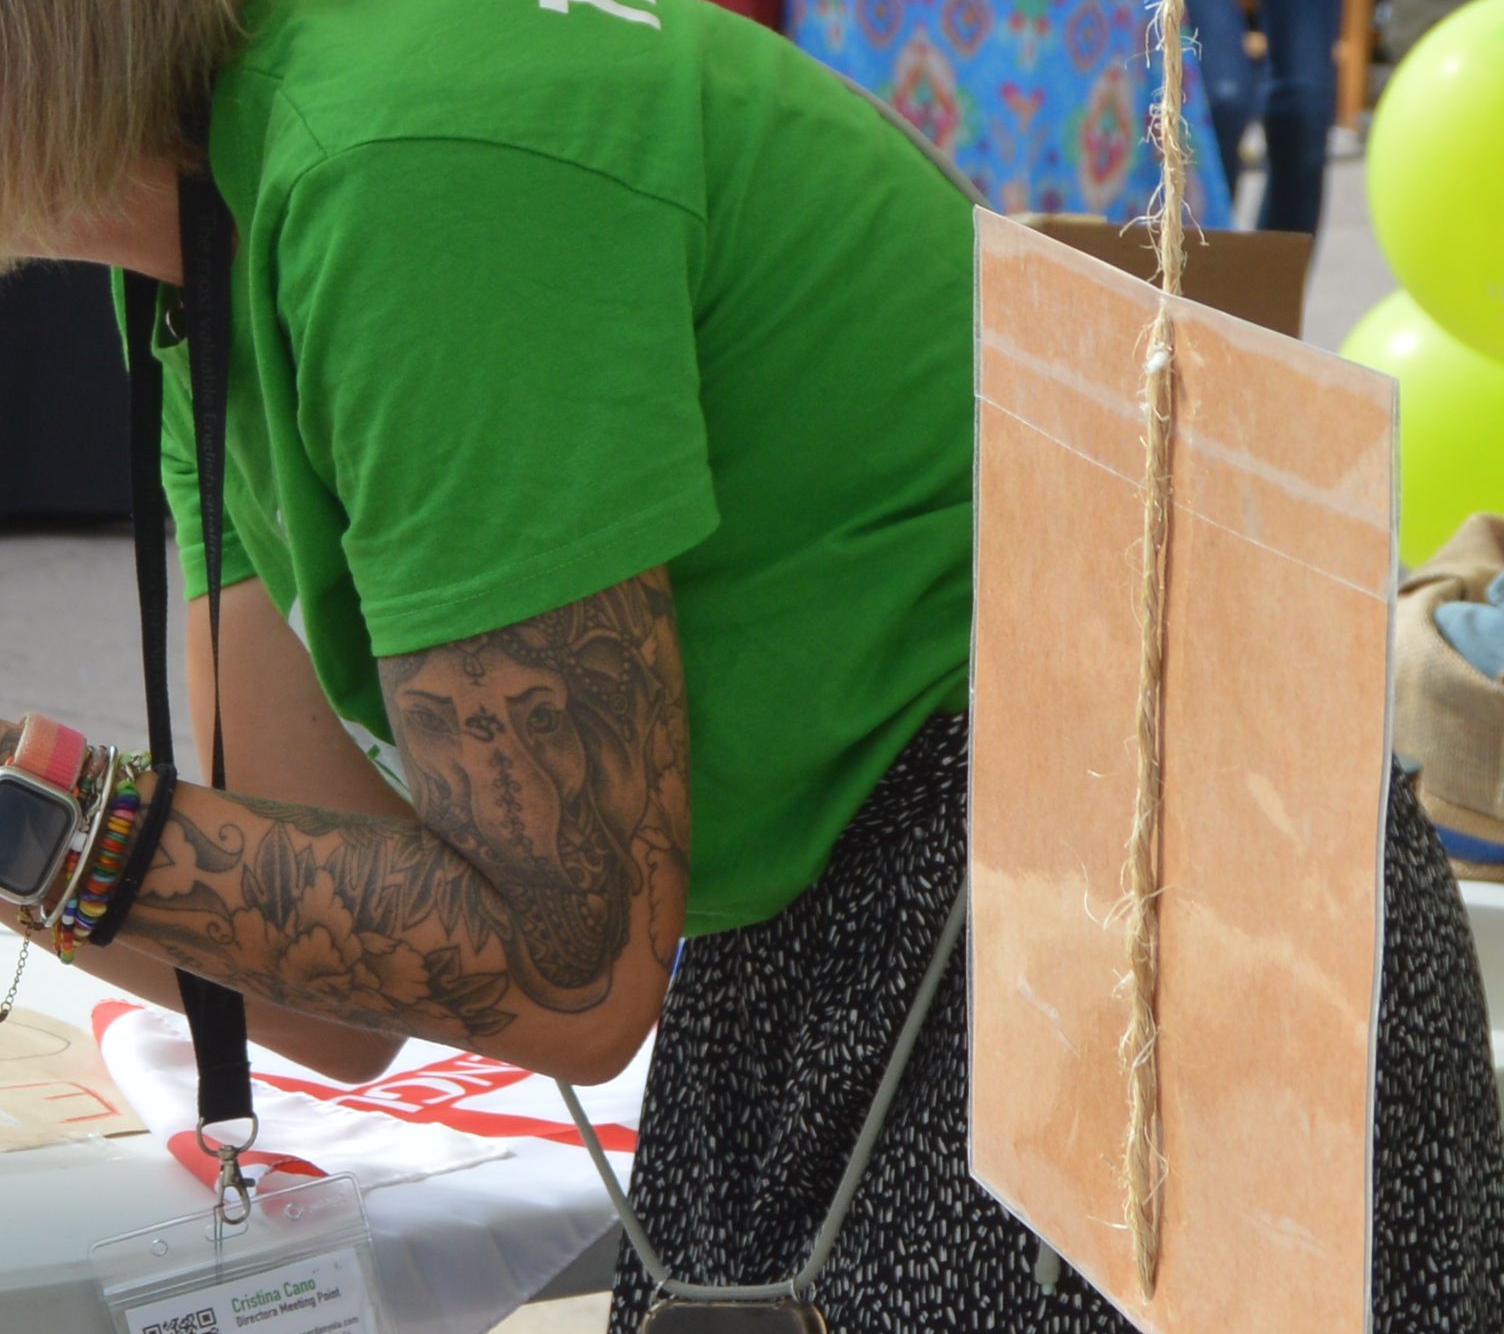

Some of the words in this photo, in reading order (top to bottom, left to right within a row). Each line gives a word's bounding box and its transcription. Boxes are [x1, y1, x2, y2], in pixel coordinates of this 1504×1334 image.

[231, 1288, 283, 1314] Cristina
[283, 1278, 317, 1297] Cano
[235, 1307, 278, 1328] Directora
[280, 1298, 317, 1315] Meeting
[317, 1287, 341, 1302] Point
